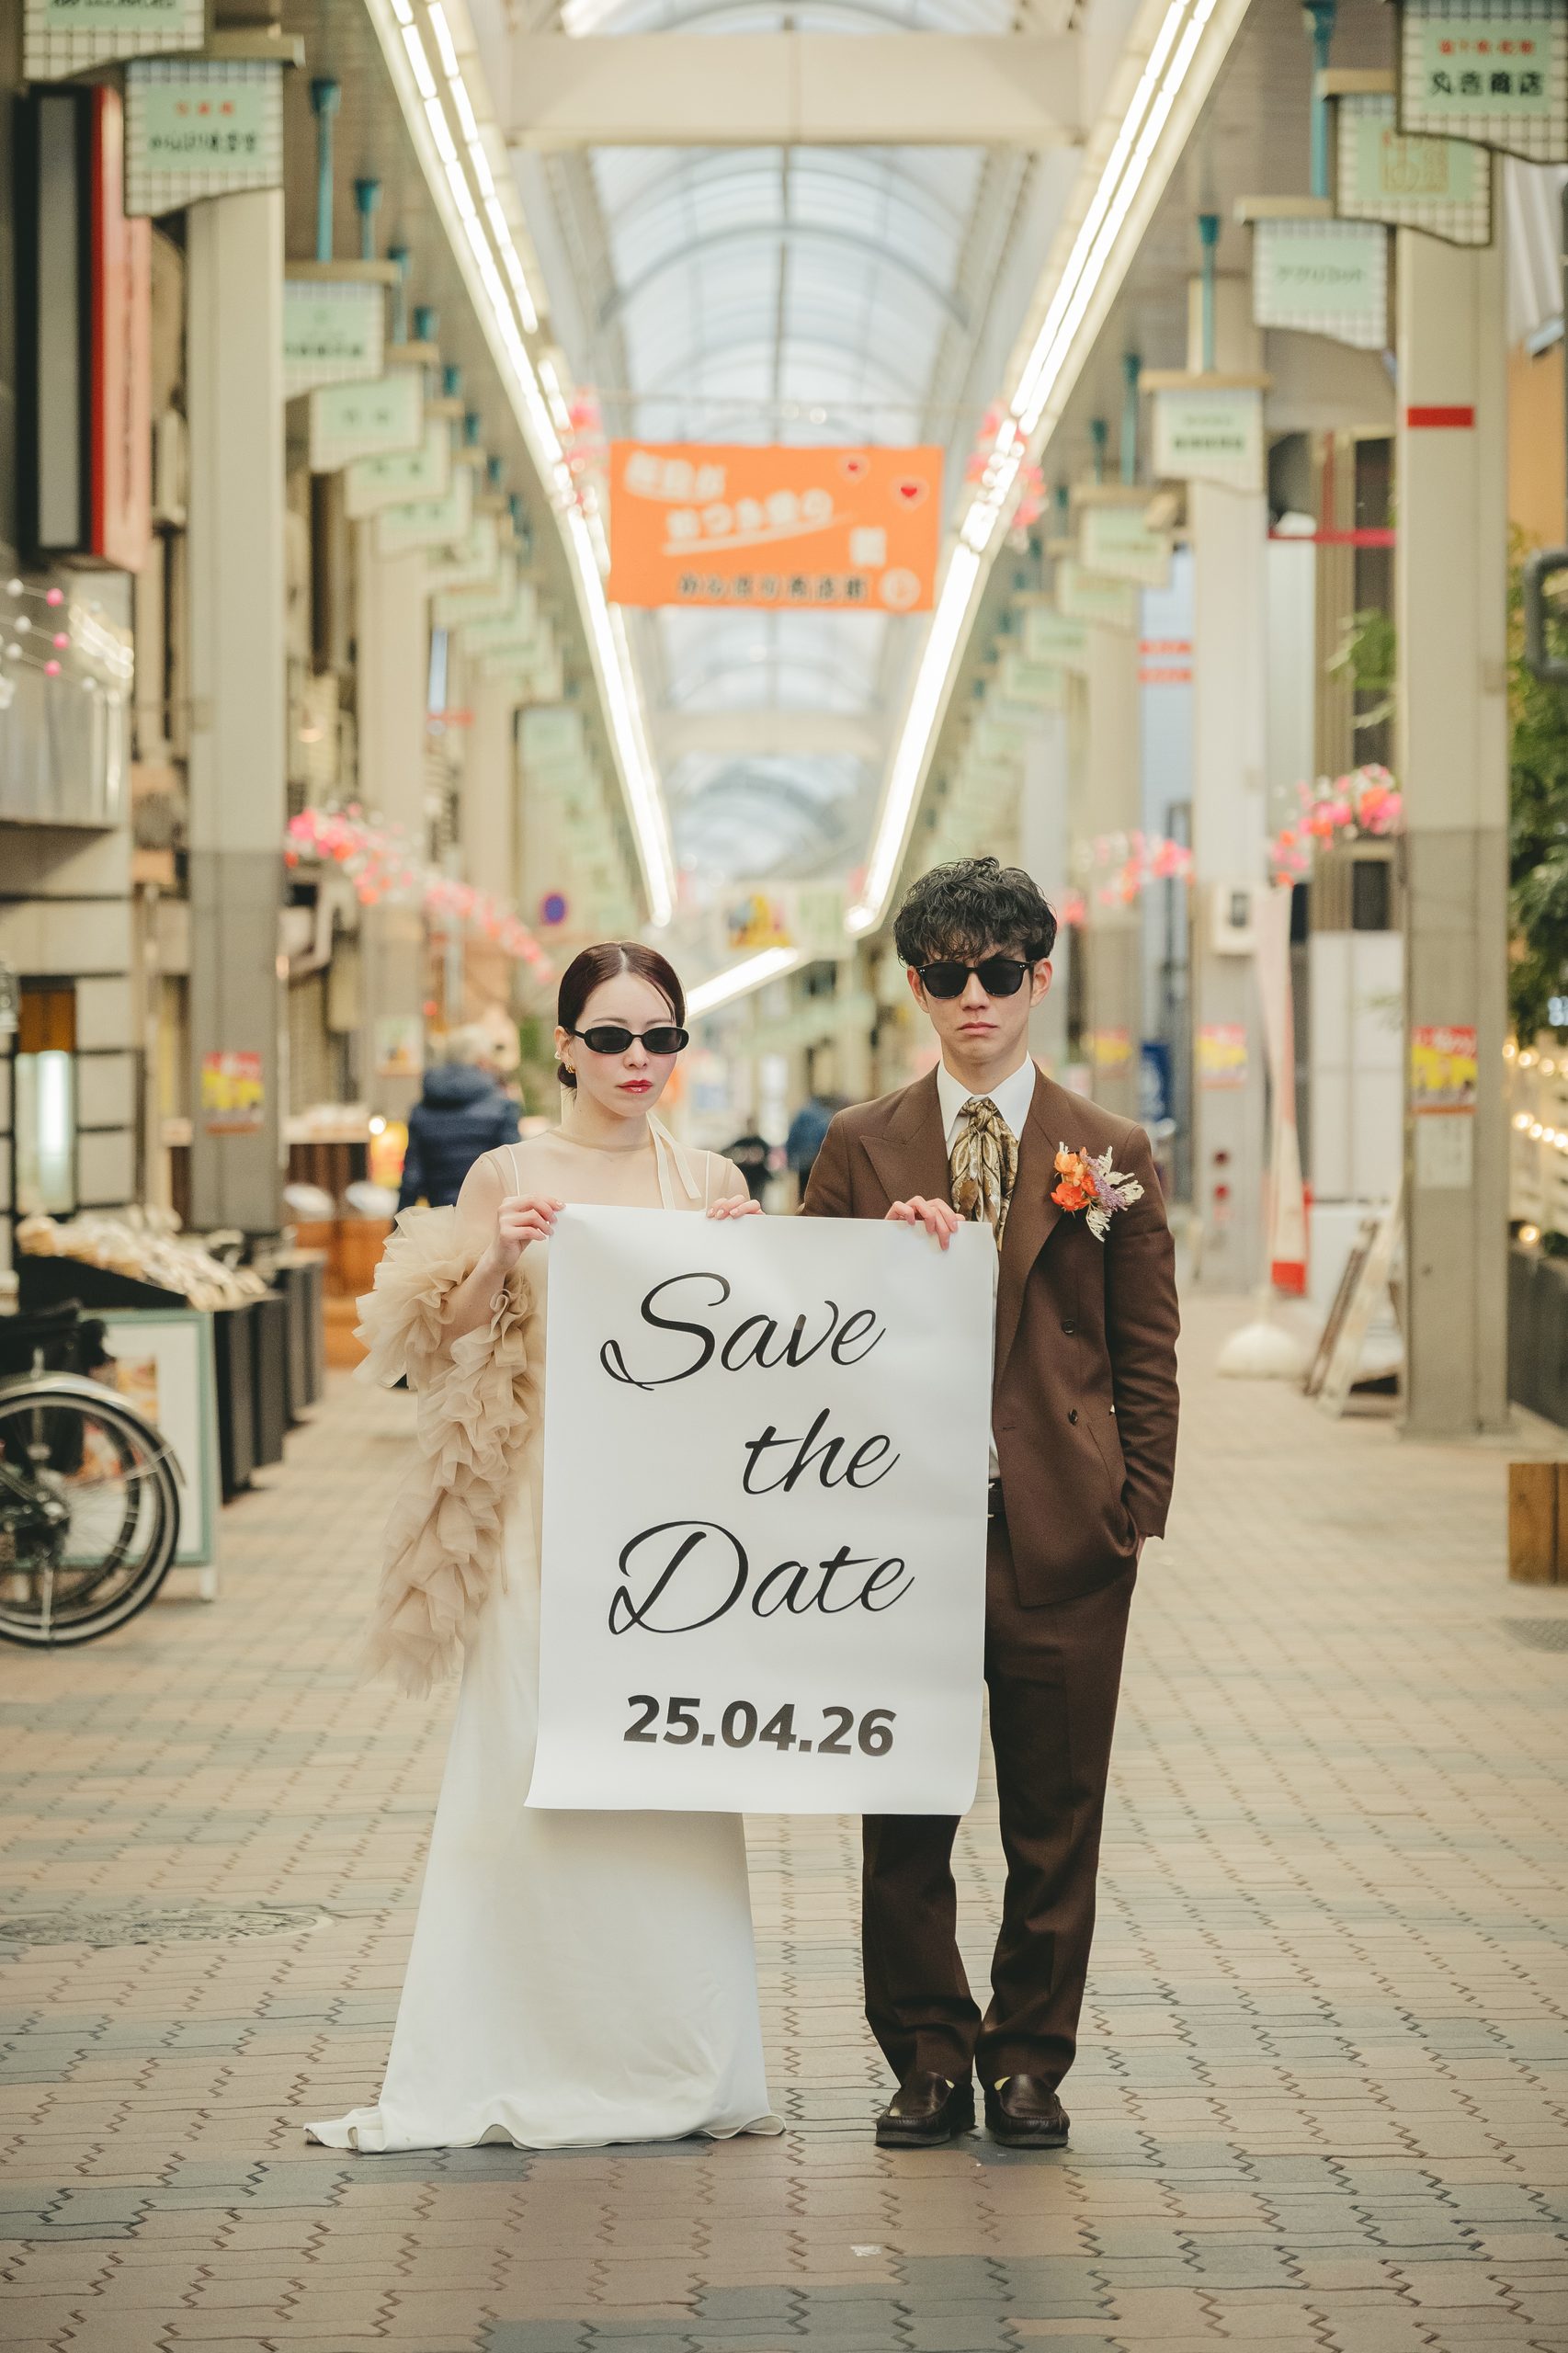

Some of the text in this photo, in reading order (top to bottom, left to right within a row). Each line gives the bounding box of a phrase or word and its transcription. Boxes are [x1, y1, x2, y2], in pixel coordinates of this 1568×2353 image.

[599, 1272, 886, 1392] Save
[742, 1407, 901, 1495] the
[608, 1520, 915, 1636] Date
[623, 1694, 897, 1756] 25.04.26
